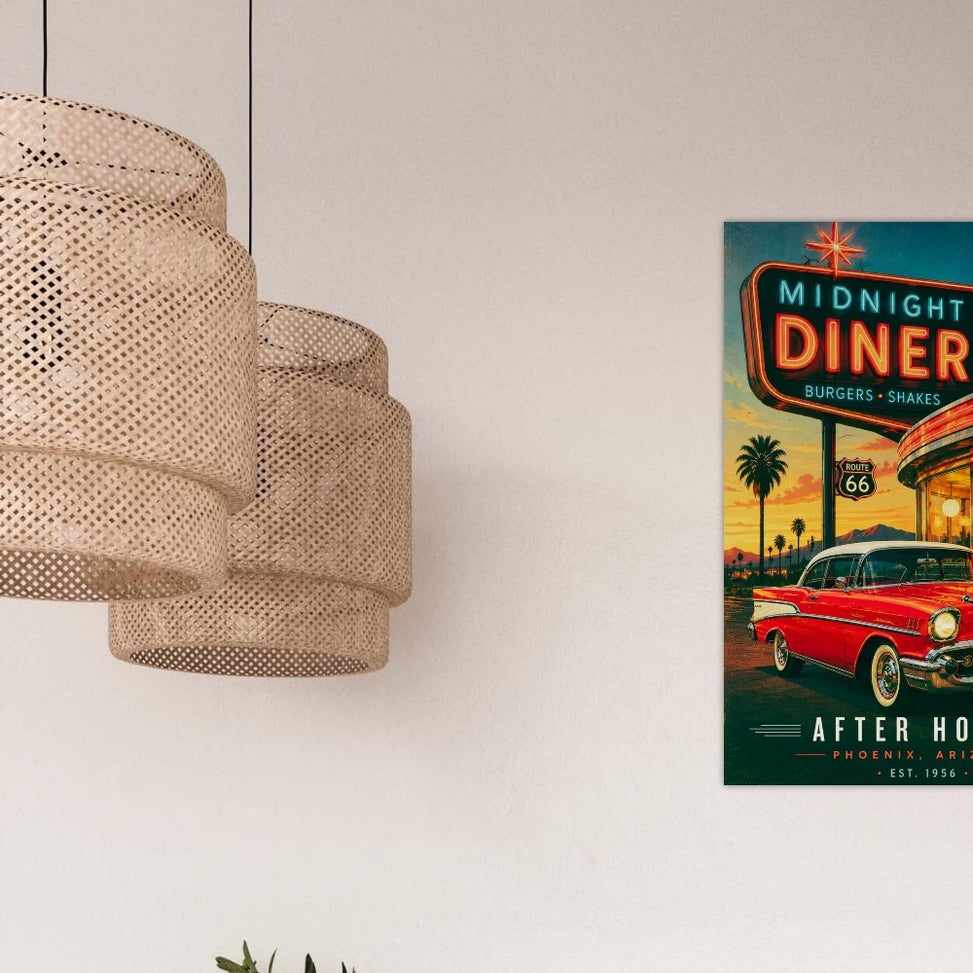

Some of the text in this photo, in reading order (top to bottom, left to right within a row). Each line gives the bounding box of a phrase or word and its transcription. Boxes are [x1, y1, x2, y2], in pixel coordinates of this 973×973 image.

[779, 280, 964, 321] MIDNIGHT
[775, 313, 970, 382] DINER
[805, 385, 941, 406] BURGERS SHAKES
[846, 463, 870, 472] ROUTE
[846, 475, 870, 493] 66
[812, 716, 909, 742] AFTER
[833, 751, 924, 761] PHOENIX,
[890, 769, 957, 778] EST. 1956
